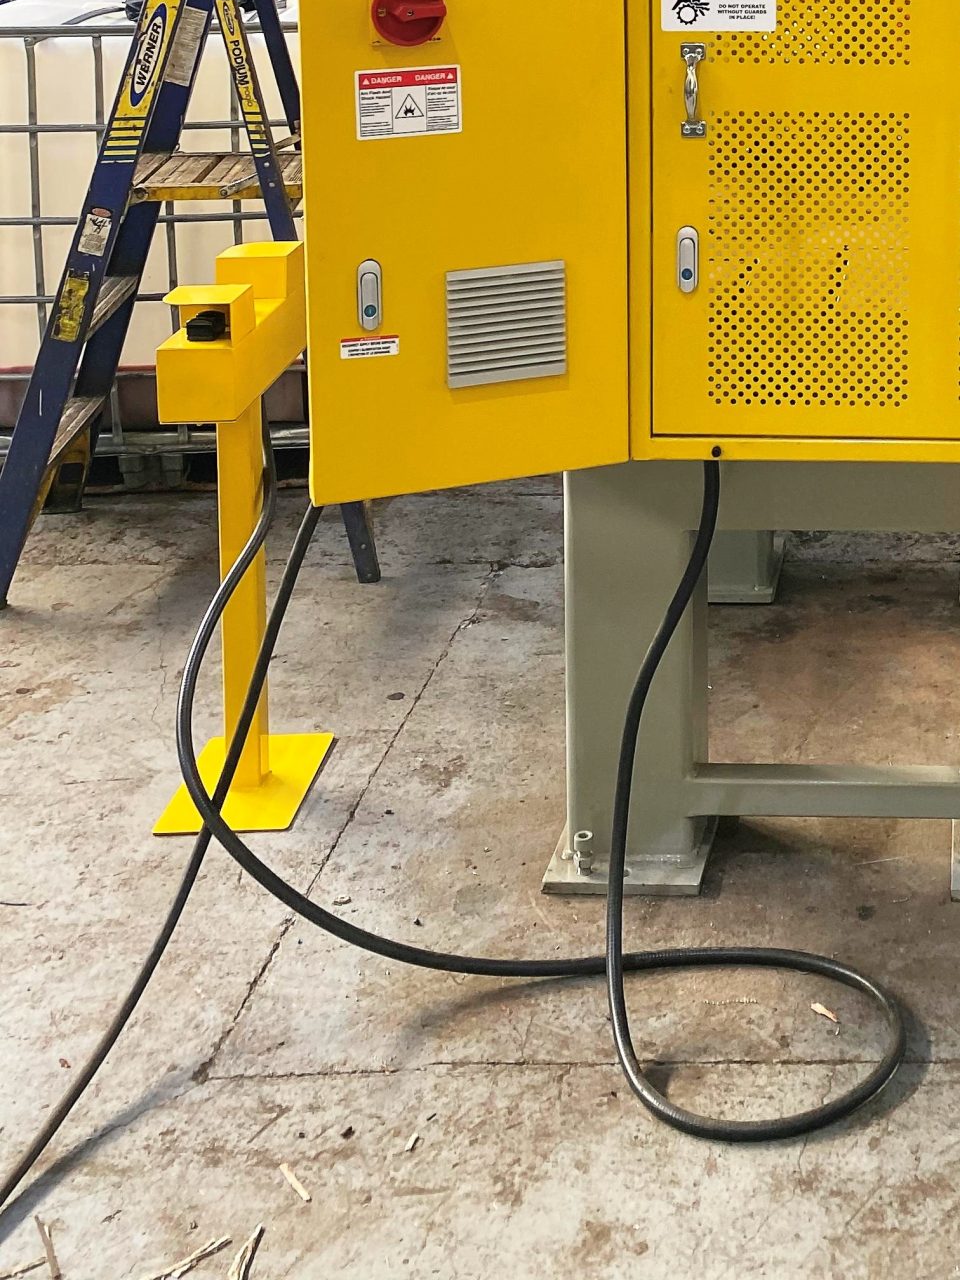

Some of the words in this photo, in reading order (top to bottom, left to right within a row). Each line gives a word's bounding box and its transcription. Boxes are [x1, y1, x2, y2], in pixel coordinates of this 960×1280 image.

[136, 21, 162, 86] WERNER
[229, 39, 250, 86] PODIUM
[371, 76, 402, 84] DANGER
[415, 73, 446, 81] DANGER
